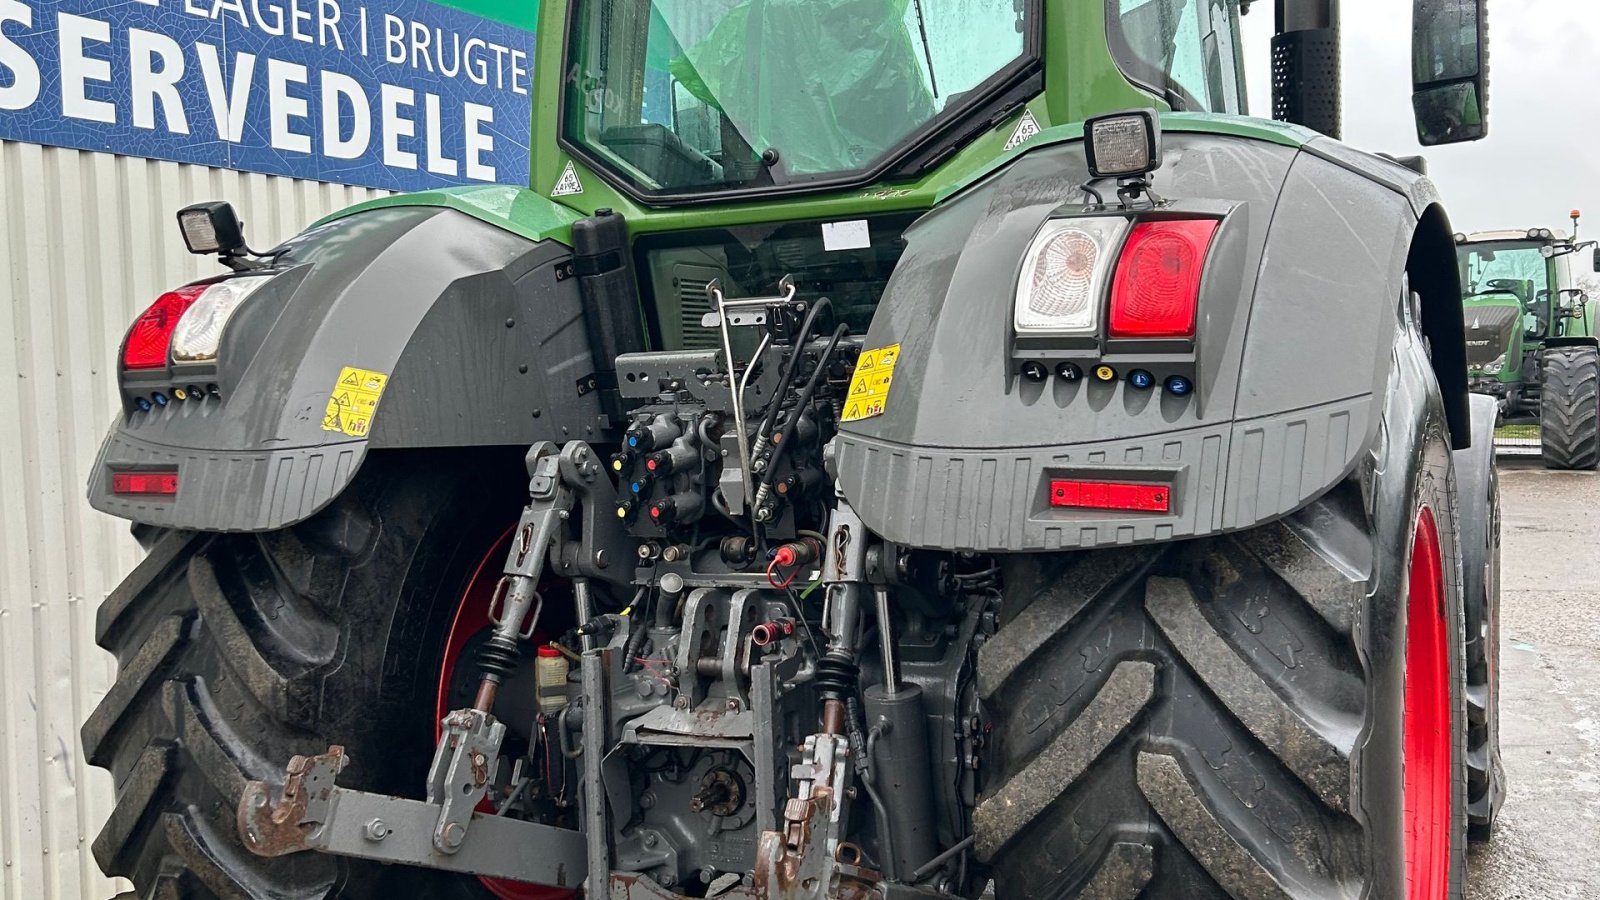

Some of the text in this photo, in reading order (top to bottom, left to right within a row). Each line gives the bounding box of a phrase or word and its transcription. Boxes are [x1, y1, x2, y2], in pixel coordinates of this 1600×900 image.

[360, 7, 368, 56] I
[385, 13, 527, 95] BRUGTE
[1021, 124, 1034, 134] 65
[565, 174, 573, 182] 65
